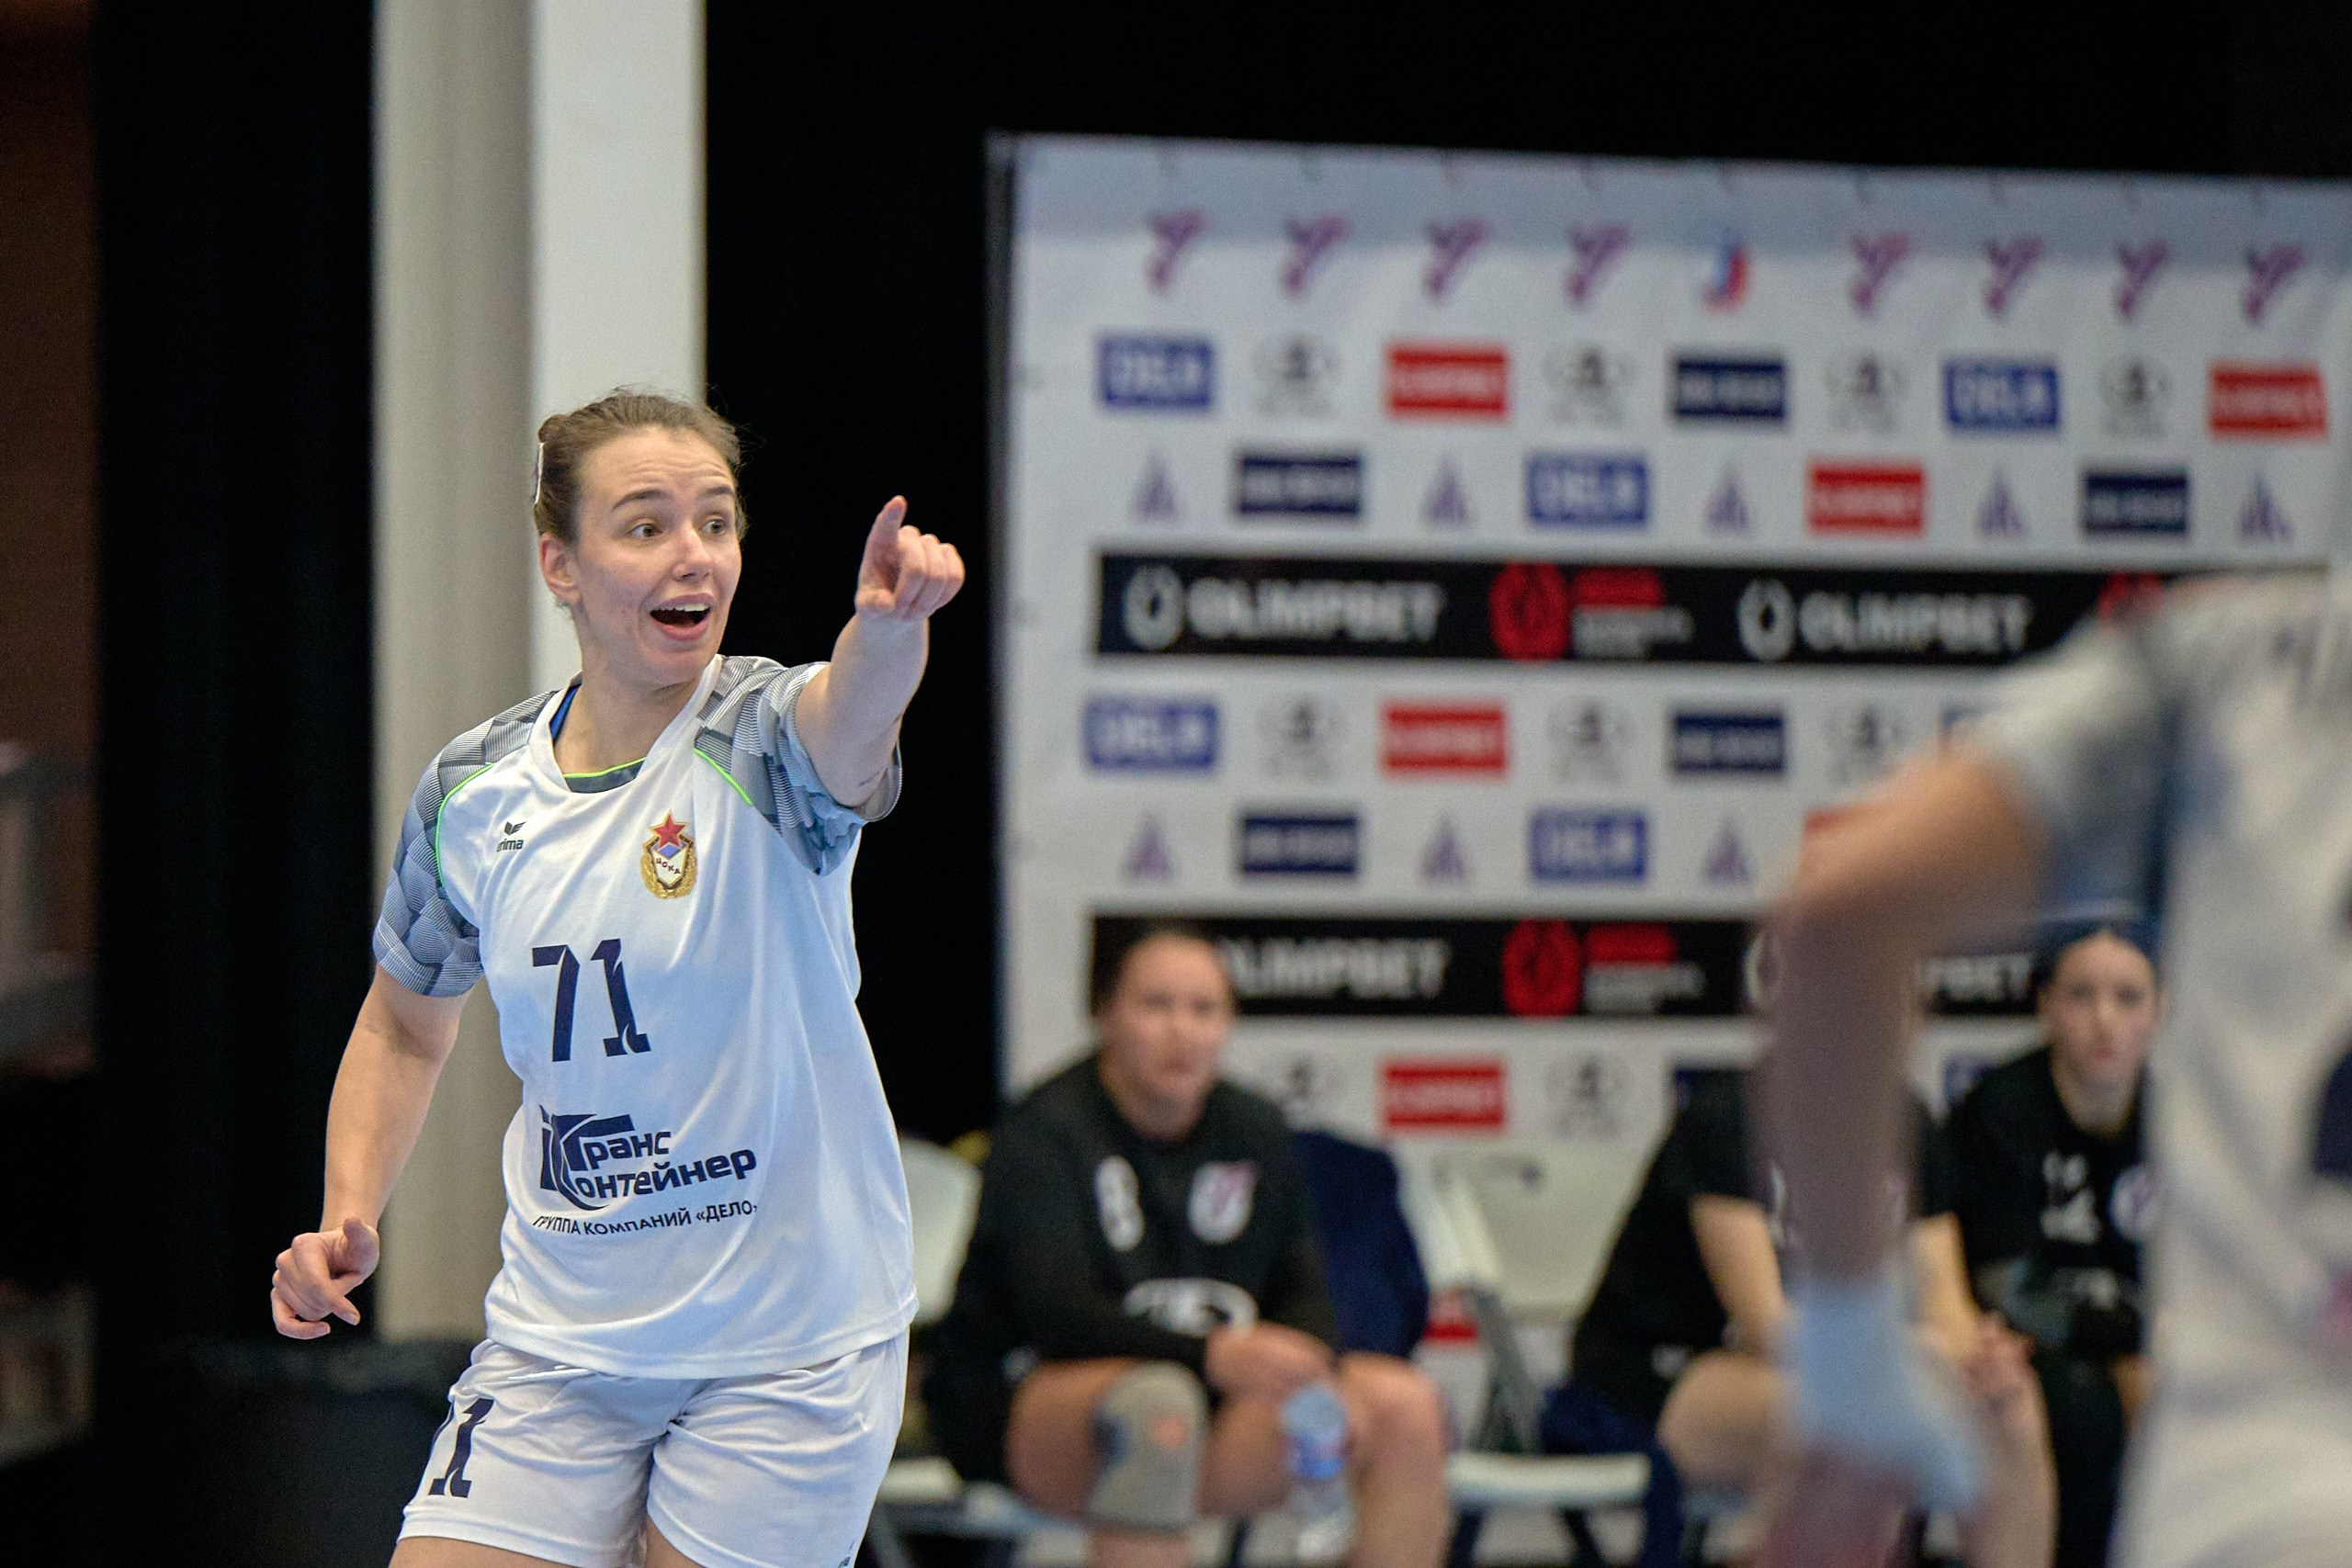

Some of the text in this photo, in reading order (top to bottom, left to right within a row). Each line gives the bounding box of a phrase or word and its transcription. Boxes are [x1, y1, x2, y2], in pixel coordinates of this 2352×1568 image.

[1190, 579, 1443, 641] OLIMPBET
[1800, 592, 2030, 651] OLIMPBET
[656, 857, 681, 874] ЦСКА
[1220, 937, 1448, 998] LIMPBET
[532, 938, 651, 1063] 71
[532, 1215, 582, 1235] ГРУППА
[584, 1207, 692, 1235] КОМПАНИЙ
